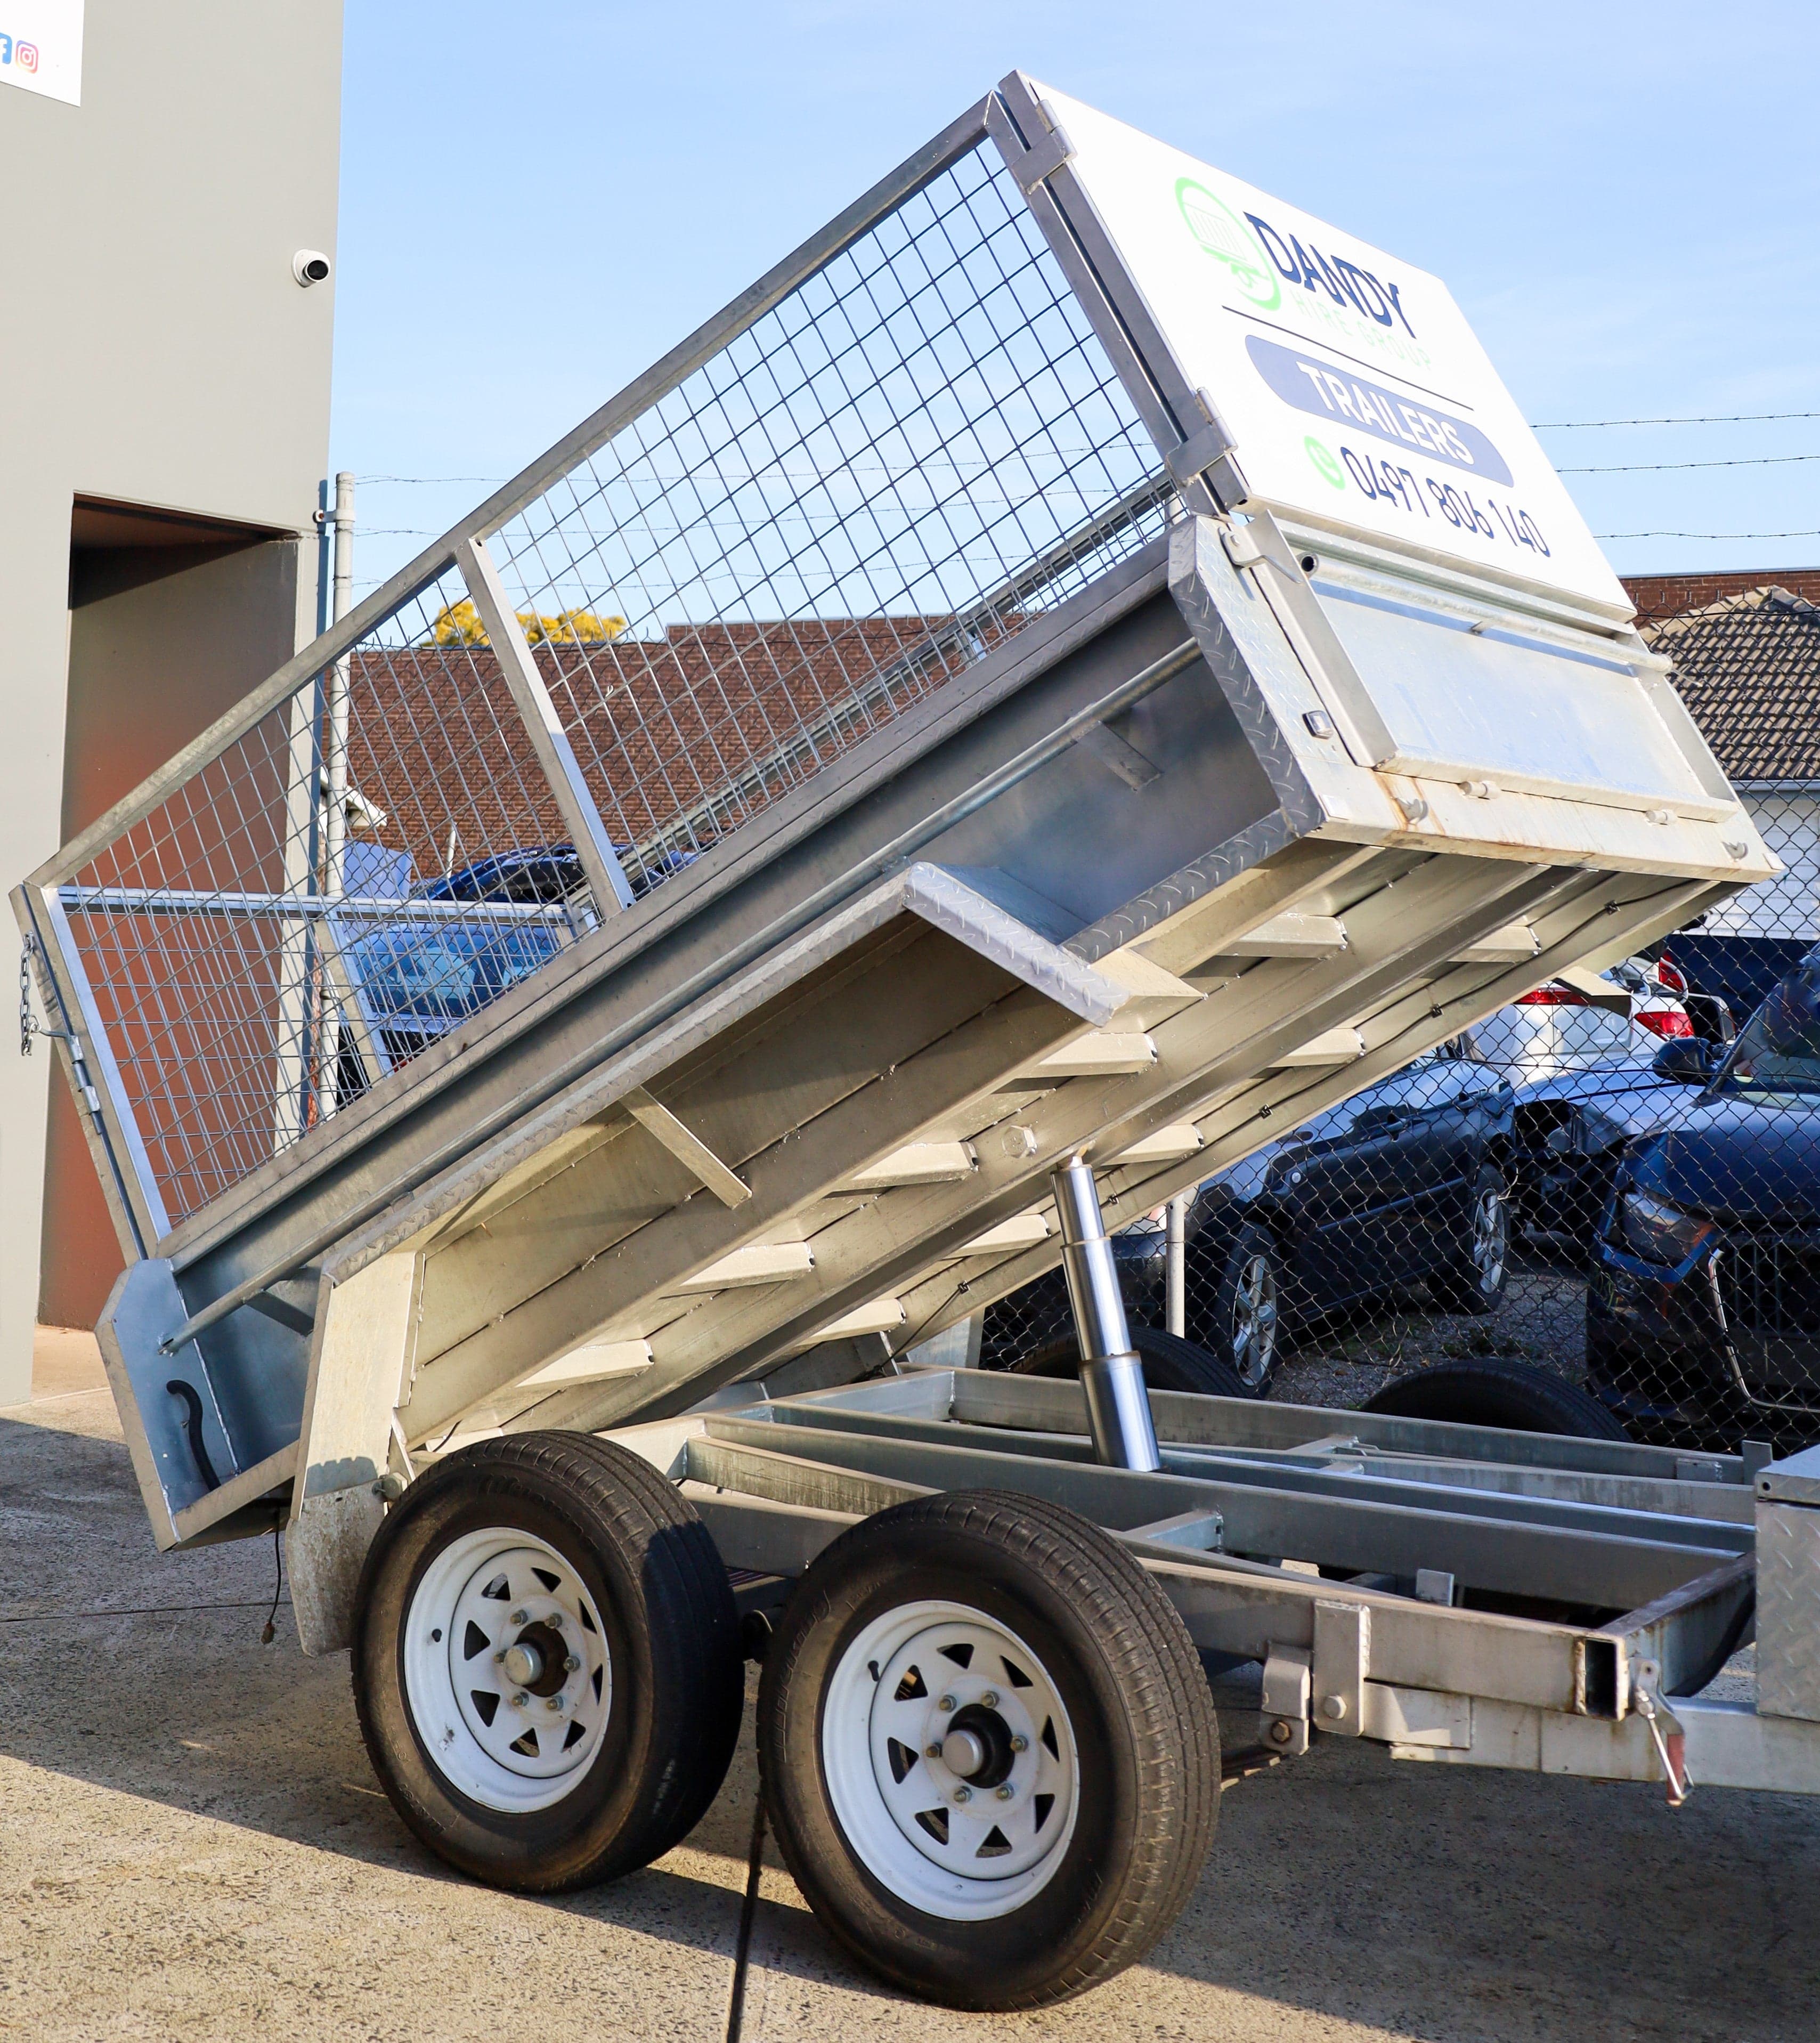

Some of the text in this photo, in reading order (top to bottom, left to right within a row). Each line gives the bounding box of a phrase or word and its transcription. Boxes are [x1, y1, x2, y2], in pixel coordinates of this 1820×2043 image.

[1243, 211, 1417, 339] DANDY
[1289, 287, 1431, 371] HIRE GROUP
[1296, 361, 1475, 465] TRAILERS
[1340, 447, 1551, 558] 0497 806 140
